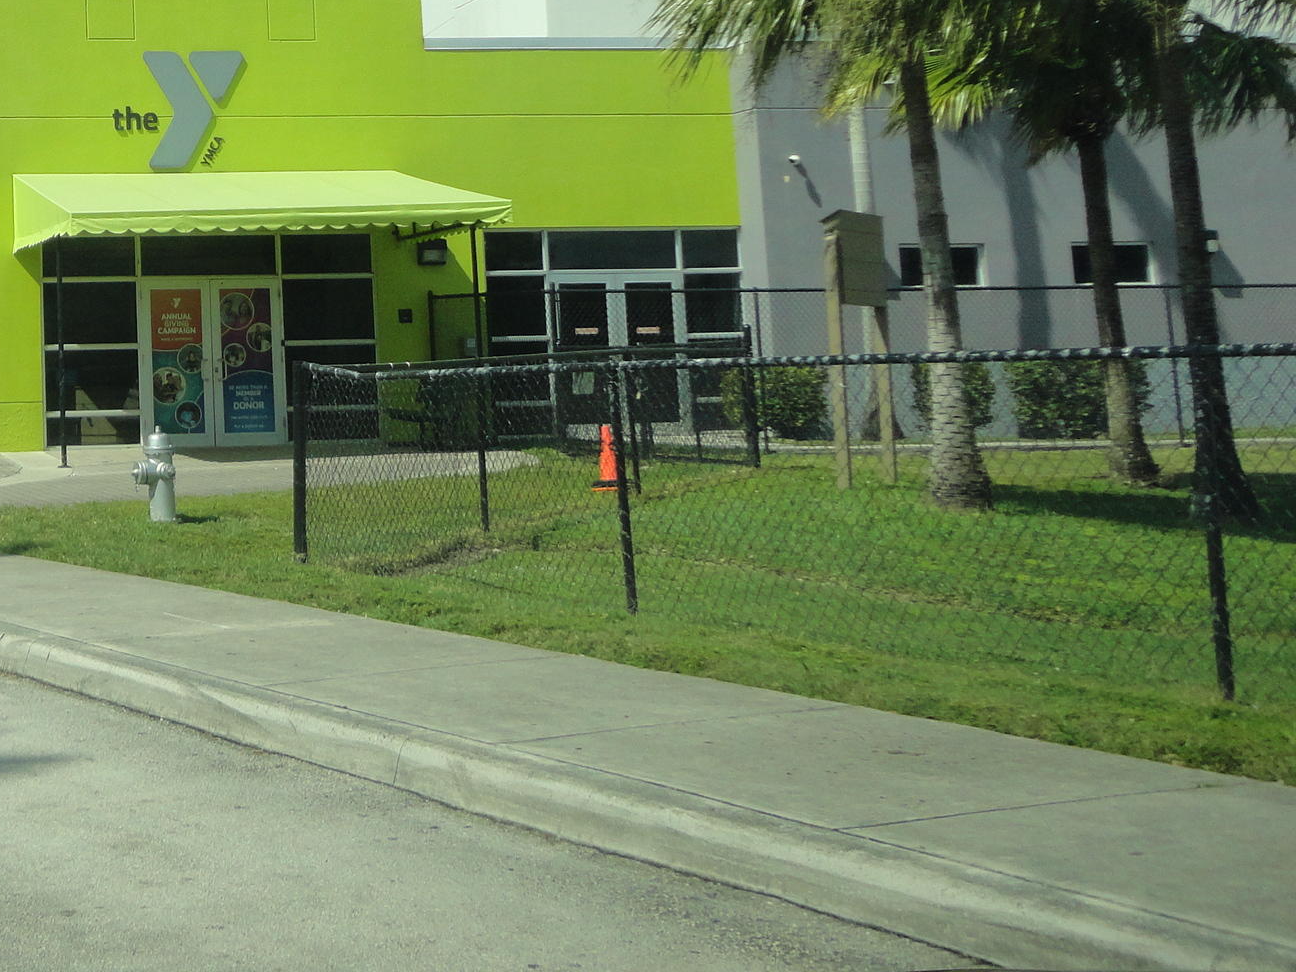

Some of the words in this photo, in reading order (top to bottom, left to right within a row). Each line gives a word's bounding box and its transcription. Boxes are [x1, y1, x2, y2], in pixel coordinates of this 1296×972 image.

[112, 106, 159, 132] the
[200, 136, 226, 167] YMCA
[233, 401, 265, 410] DONOR
